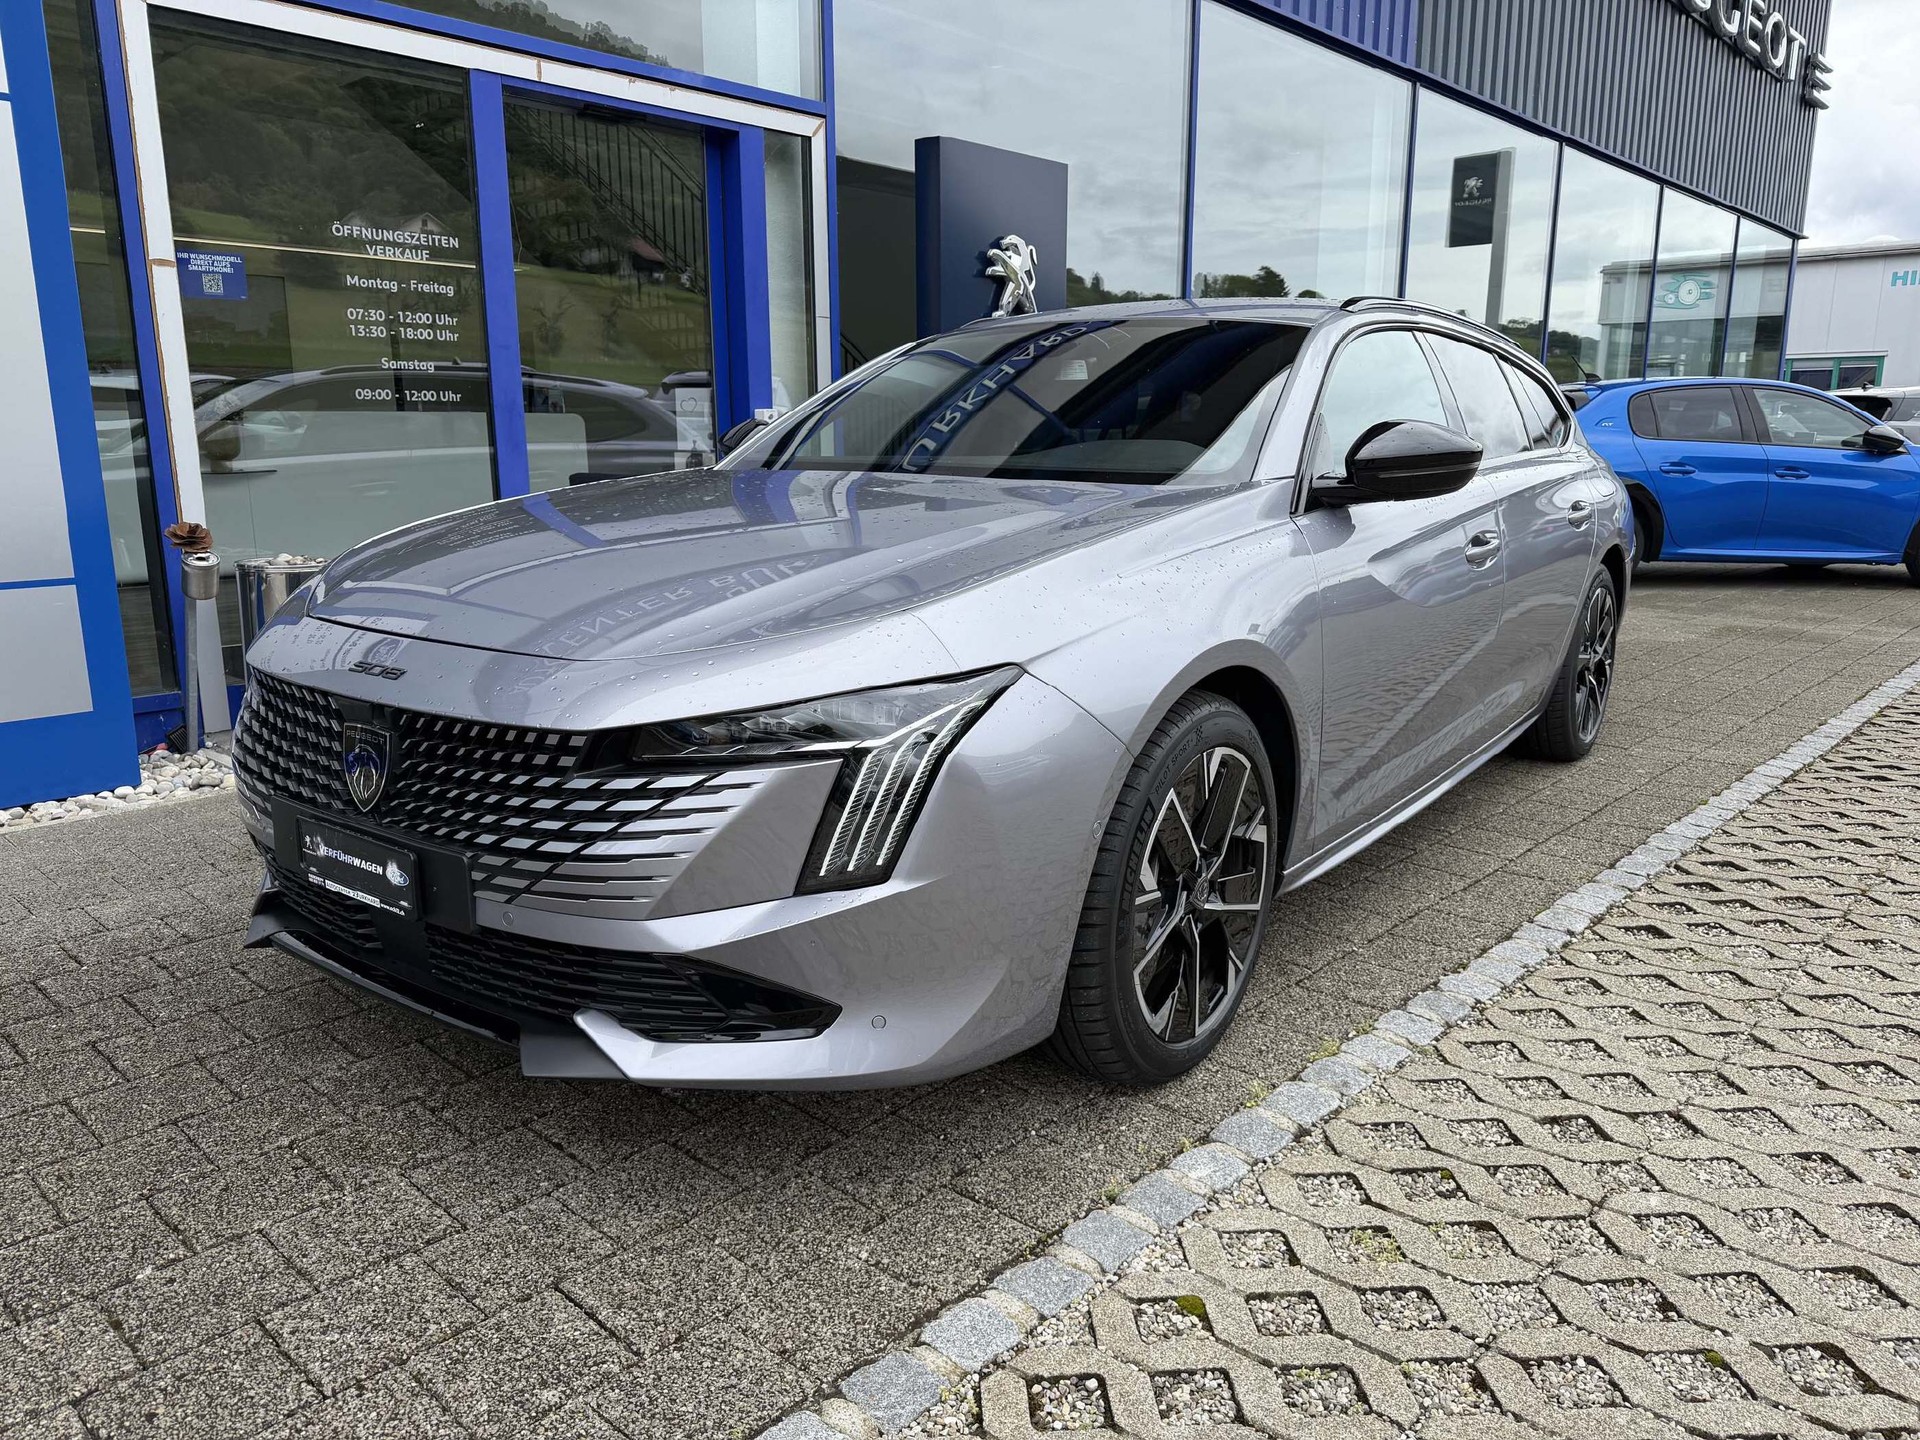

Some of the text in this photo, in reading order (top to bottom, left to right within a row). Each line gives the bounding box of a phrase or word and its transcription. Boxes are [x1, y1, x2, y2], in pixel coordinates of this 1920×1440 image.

[1683, 0, 1806, 82] GEOT
[331, 221, 459, 249] ÖFFNUNGSZEITEN
[366, 244, 430, 261] VERKAUF
[346, 274, 398, 292] Montag
[410, 280, 454, 296] Freitag
[1890, 269, 1920, 287] HI
[346, 308, 386, 321] 07:30
[397, 311, 433, 325] 12:00
[435, 314, 458, 326] Uhr
[349, 325, 387, 338] 13:30
[399, 327, 434, 340] 18:00
[436, 330, 459, 342] Uhr
[381, 357, 435, 373] Samstag
[355, 388, 392, 401] 09:00
[404, 390, 437, 402] 12:00
[440, 391, 462, 402] Uhr
[348, 660, 408, 681] 508
[346, 729, 385, 746] PEUGEOT
[319, 844, 383, 875] VERFÜHRWAGEN
